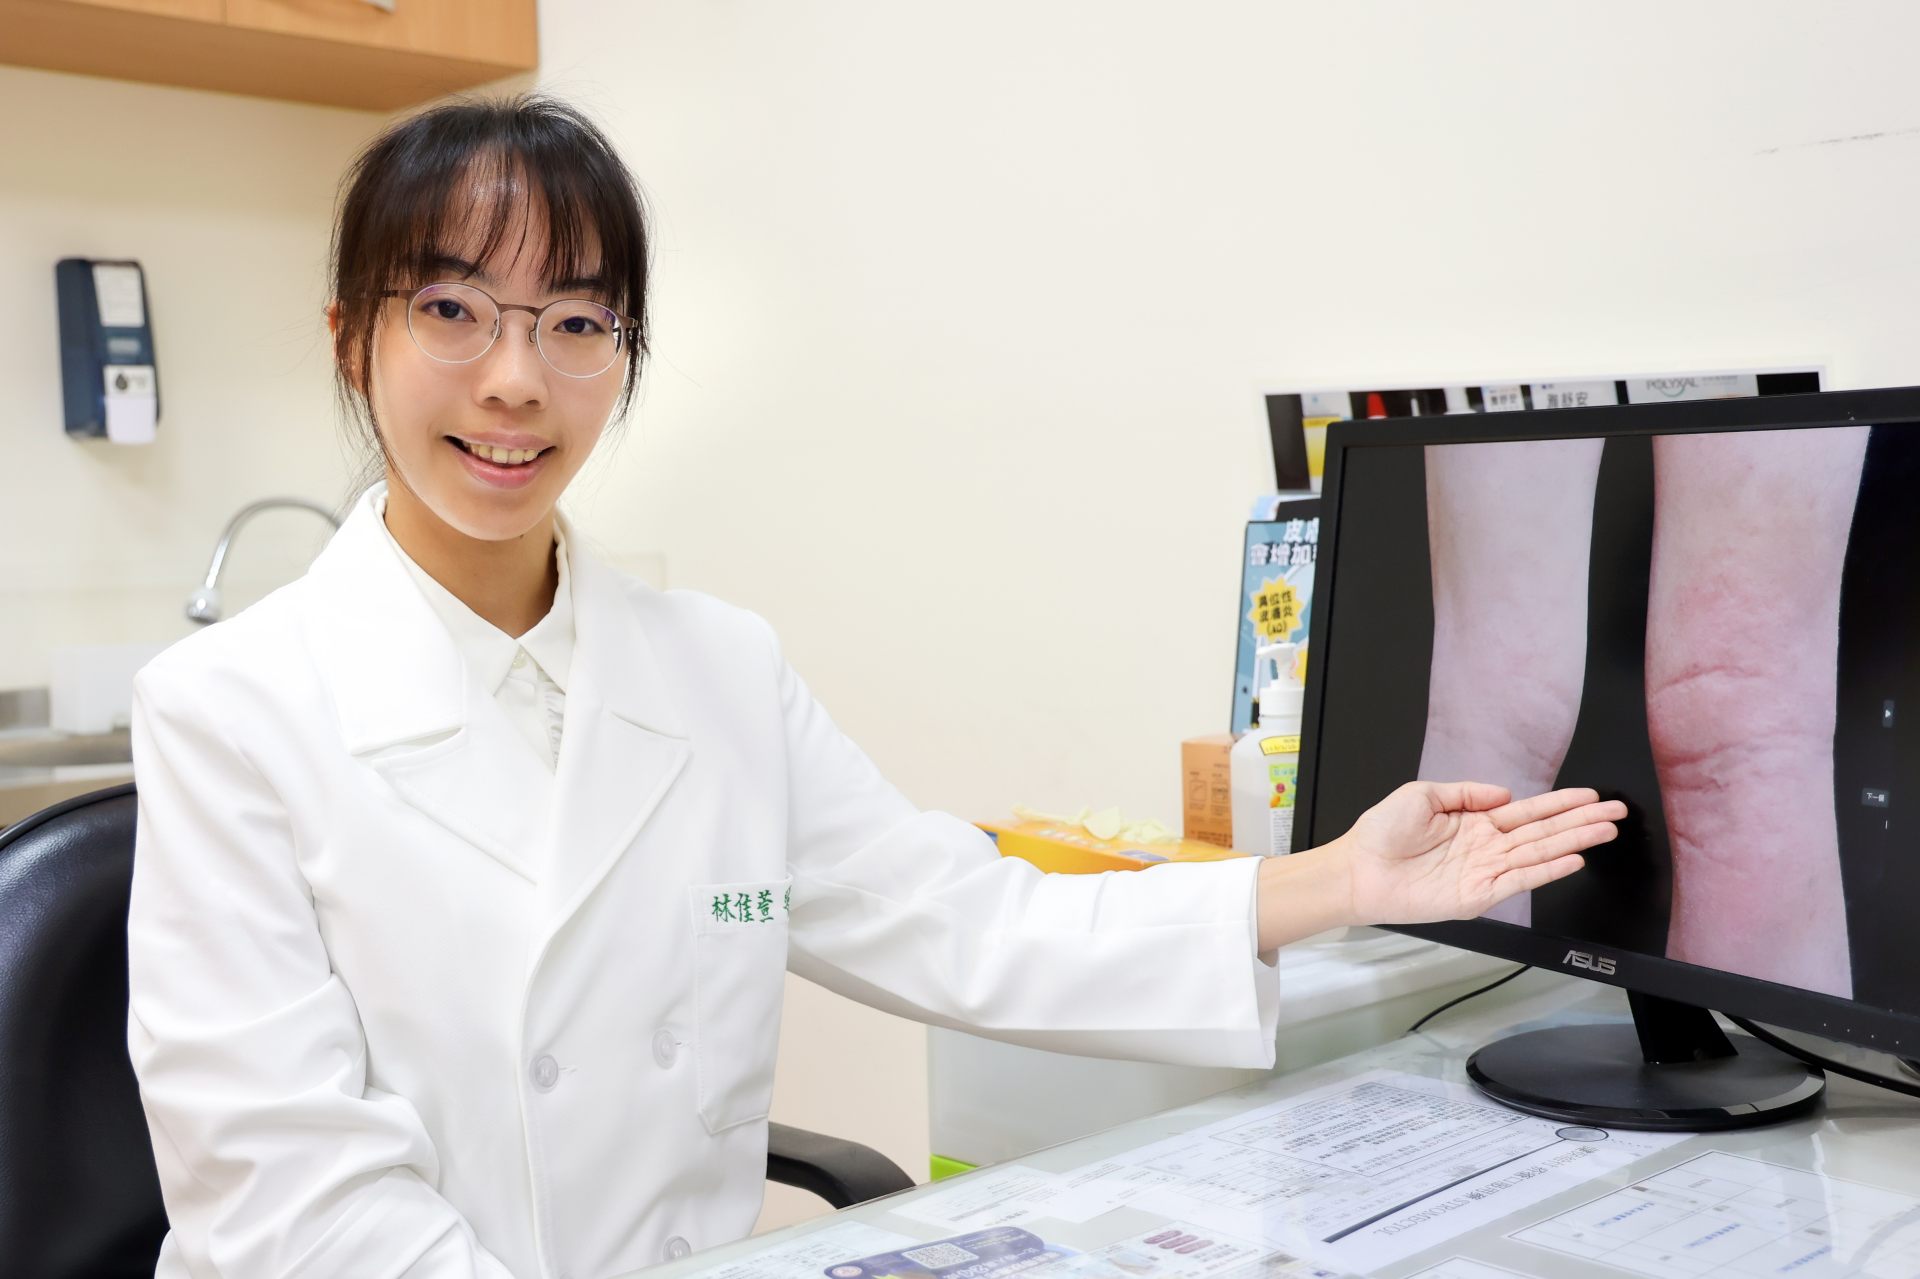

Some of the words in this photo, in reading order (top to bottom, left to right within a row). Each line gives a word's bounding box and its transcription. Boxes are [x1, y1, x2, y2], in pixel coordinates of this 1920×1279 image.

[1250, 542, 1317, 566] 會增加
[711, 889, 774, 923] 林佳萱
[1562, 949, 1616, 975] ASUS
[1373, 1196, 1471, 1235] STROMECTOL
